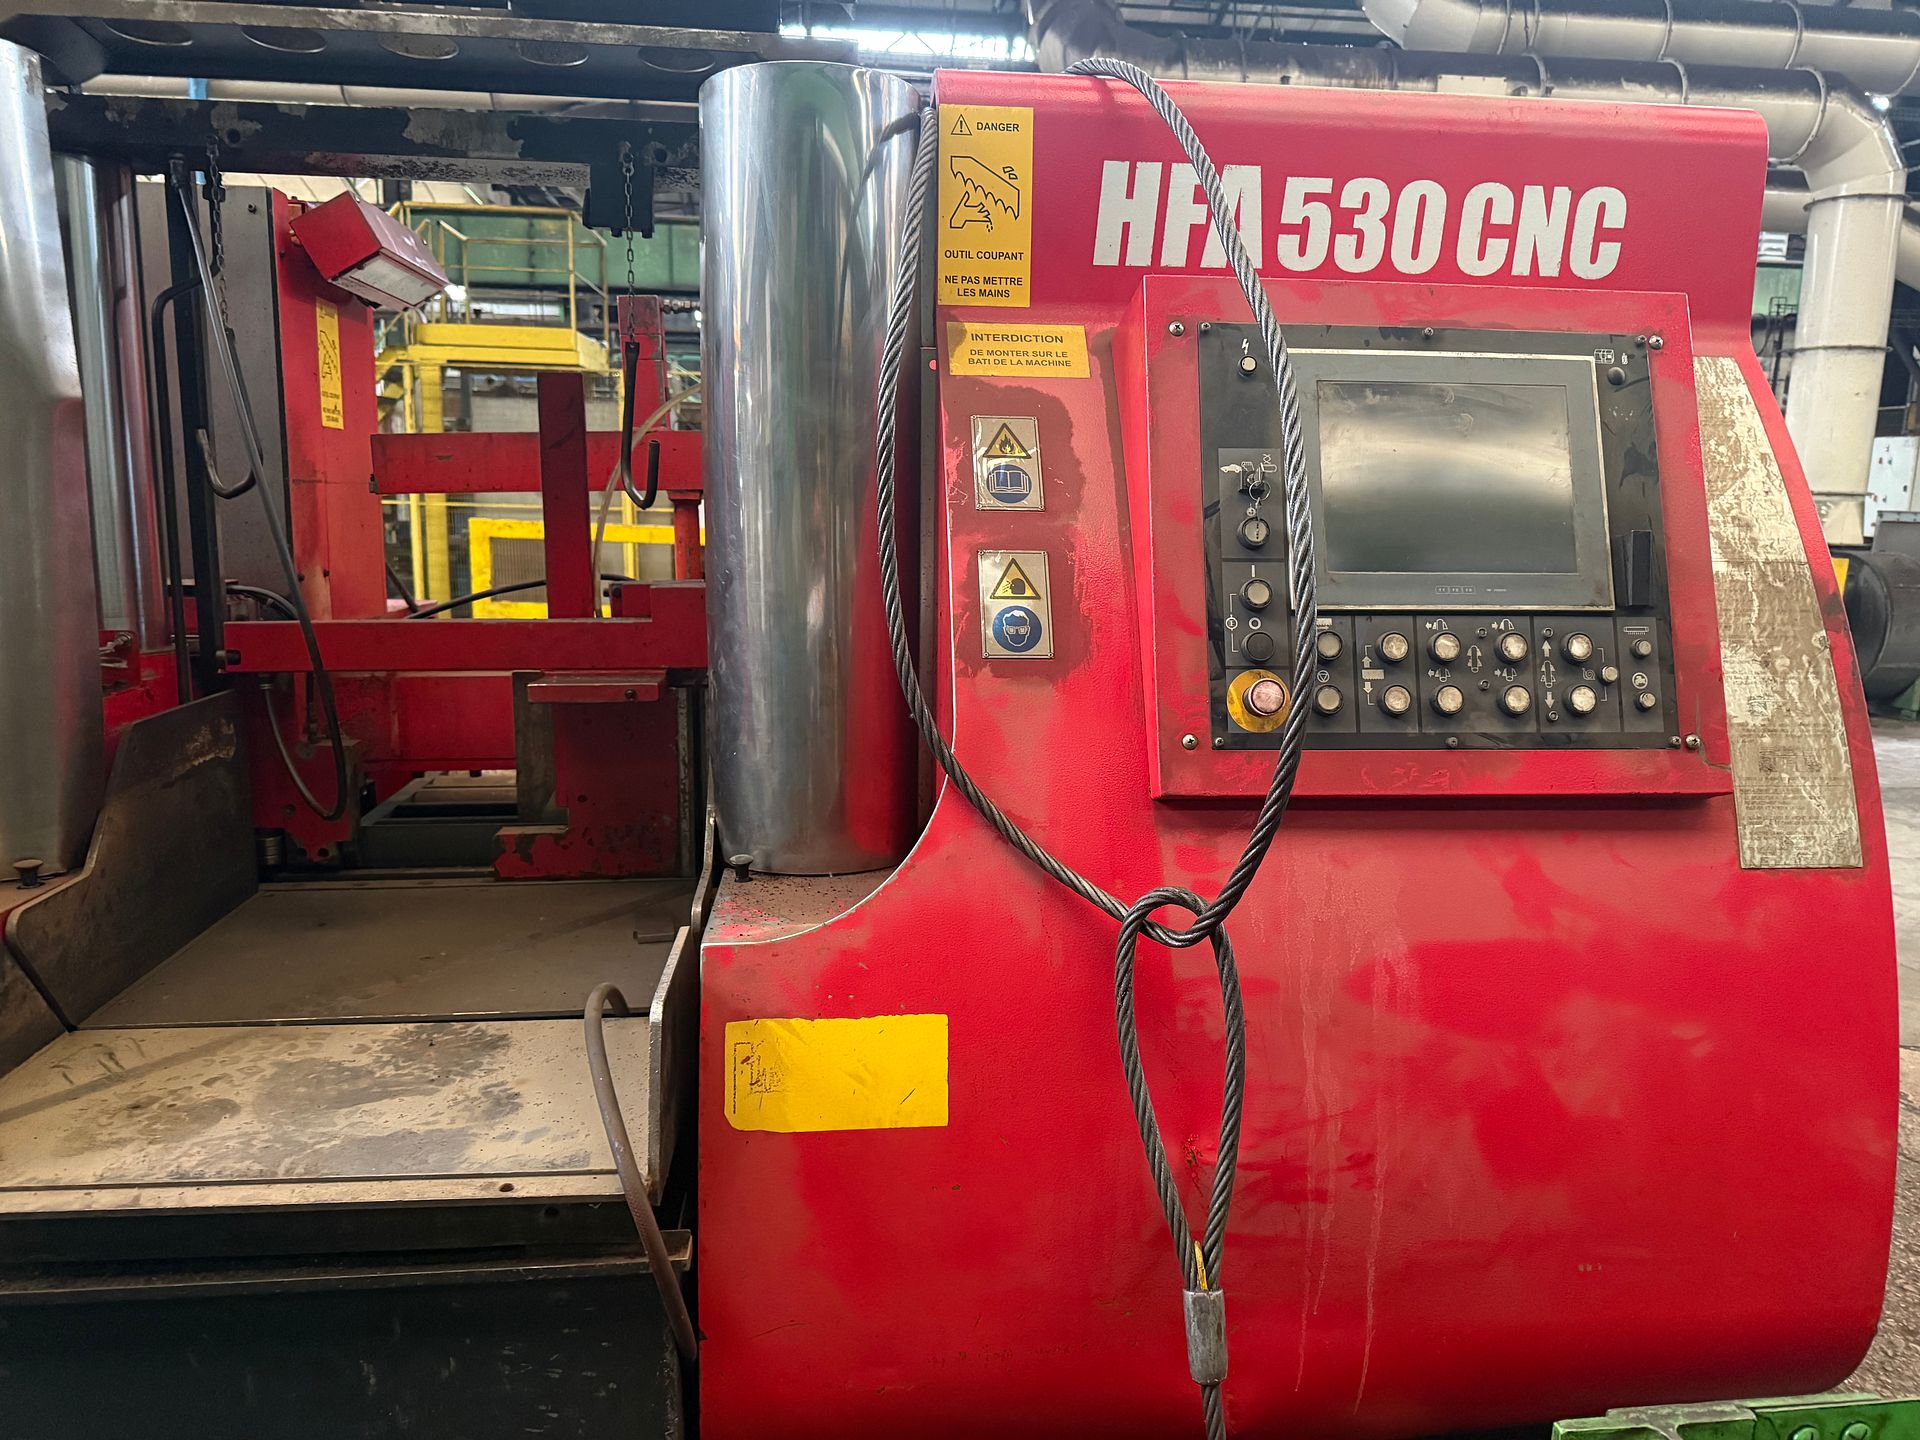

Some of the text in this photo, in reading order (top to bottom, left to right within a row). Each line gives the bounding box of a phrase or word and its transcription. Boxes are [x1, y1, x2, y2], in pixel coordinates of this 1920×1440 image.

[976, 121, 1020, 132] DANGER
[1092, 160, 1627, 280] HFA 530 CNC
[944, 249, 1025, 261] OUTIL COUPANT
[944, 275, 1023, 286] NE PAS METTRE
[957, 288, 1011, 298] LES MAINS
[970, 333, 1064, 344] INTERDICTION
[986, 349, 1029, 358] MONTER
[1031, 350, 1053, 358] SUR
[993, 358, 1008, 366] DE
[1025, 359, 1072, 367] MACHINE
